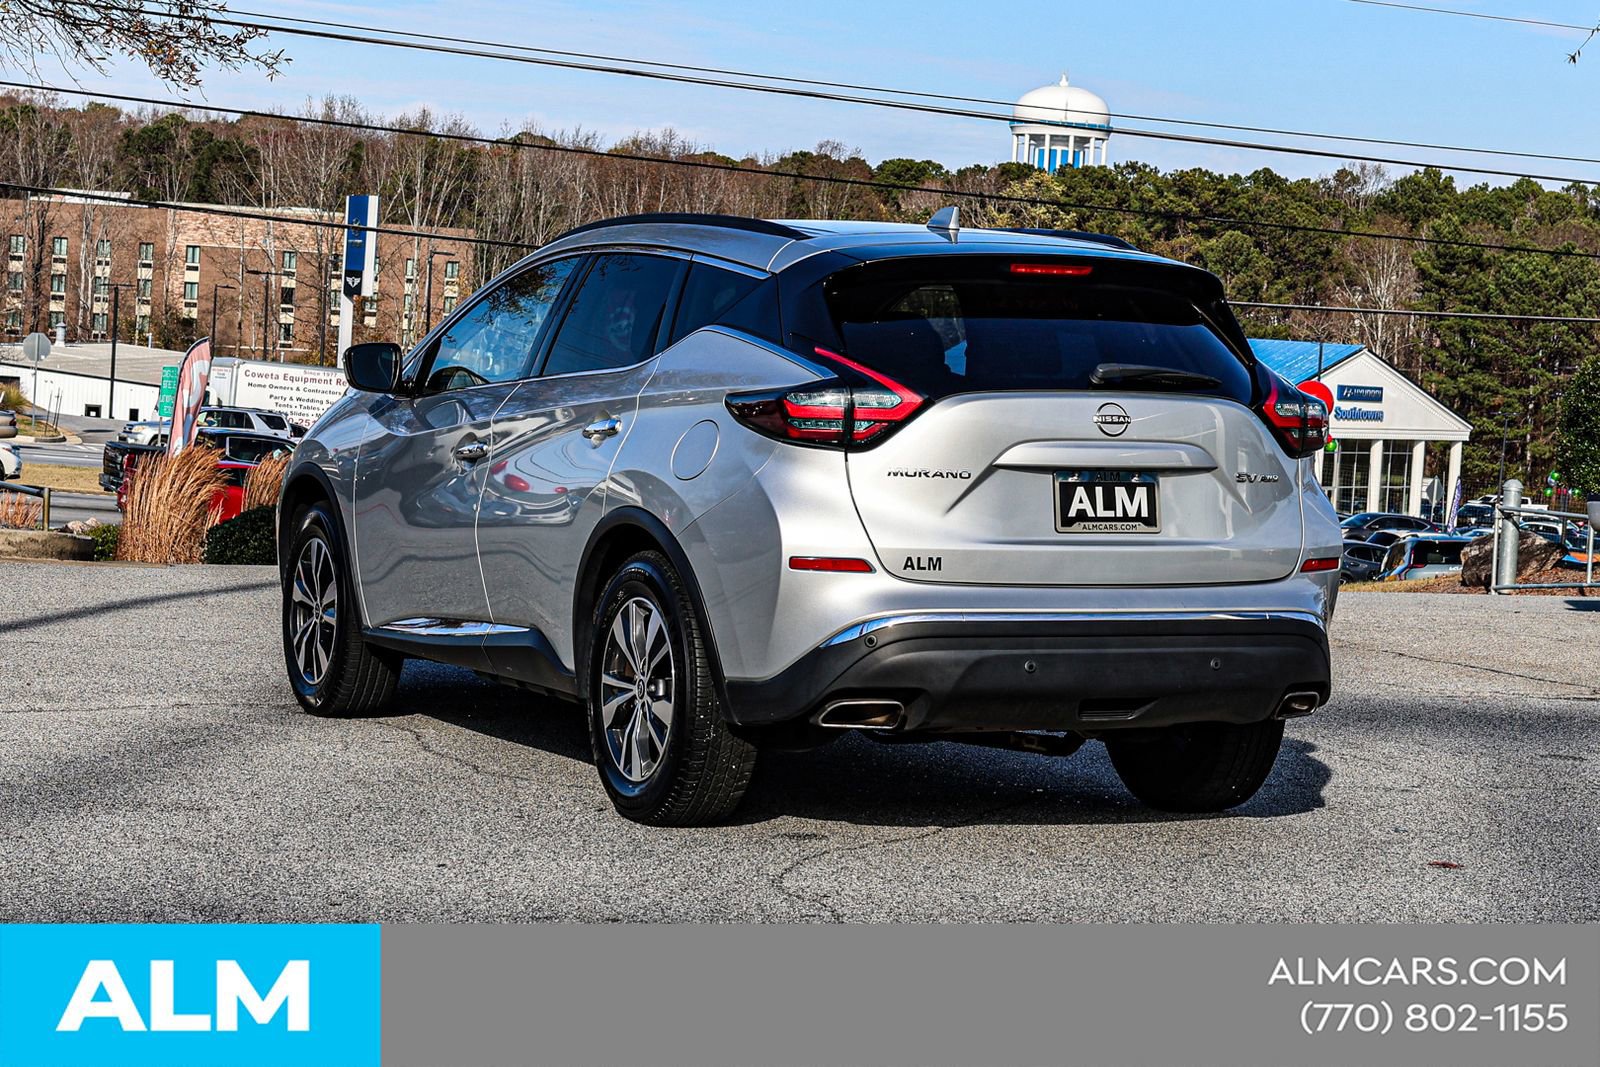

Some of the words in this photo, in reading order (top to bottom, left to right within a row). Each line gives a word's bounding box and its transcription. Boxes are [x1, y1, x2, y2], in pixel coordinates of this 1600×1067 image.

[244, 369, 280, 380] Coweta
[283, 373, 333, 385] Equipment
[268, 383, 294, 391] Owners
[303, 386, 342, 396] Contractors
[269, 394, 287, 402] Party
[296, 396, 324, 405] Wedding
[299, 404, 321, 412] Tables
[1093, 415, 1131, 423] NISSAN
[887, 467, 972, 480] MURANO
[1067, 486, 1149, 518] ALM
[1081, 523, 1138, 531] ALMCARS.COM
[902, 556, 943, 571] ALM
